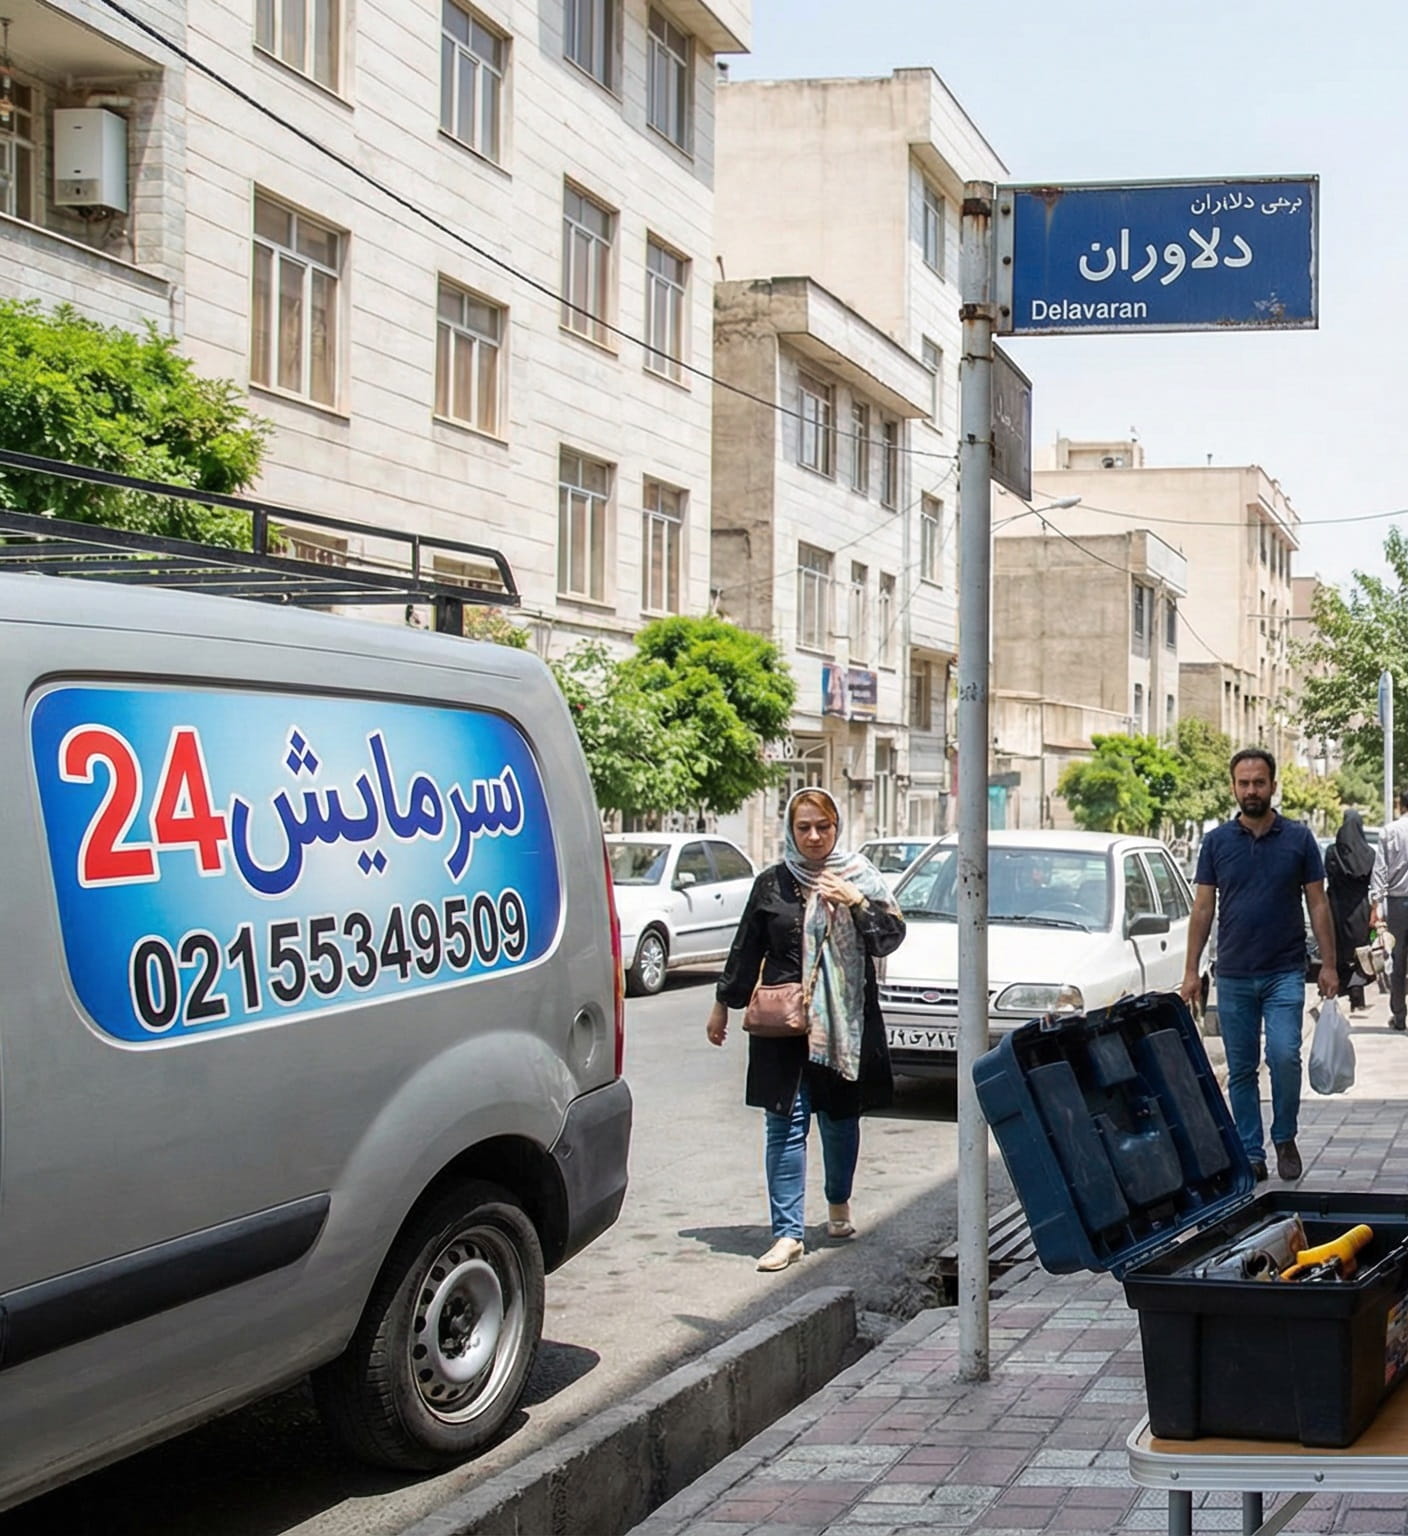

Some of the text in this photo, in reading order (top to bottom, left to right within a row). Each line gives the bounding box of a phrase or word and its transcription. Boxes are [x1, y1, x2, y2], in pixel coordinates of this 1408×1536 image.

[1079, 227, 1253, 286] دلاوران
[1031, 299, 1147, 320] Delavaran
[65, 729, 522, 894] سرمایش 24
[133, 891, 526, 1028] 02155349509
